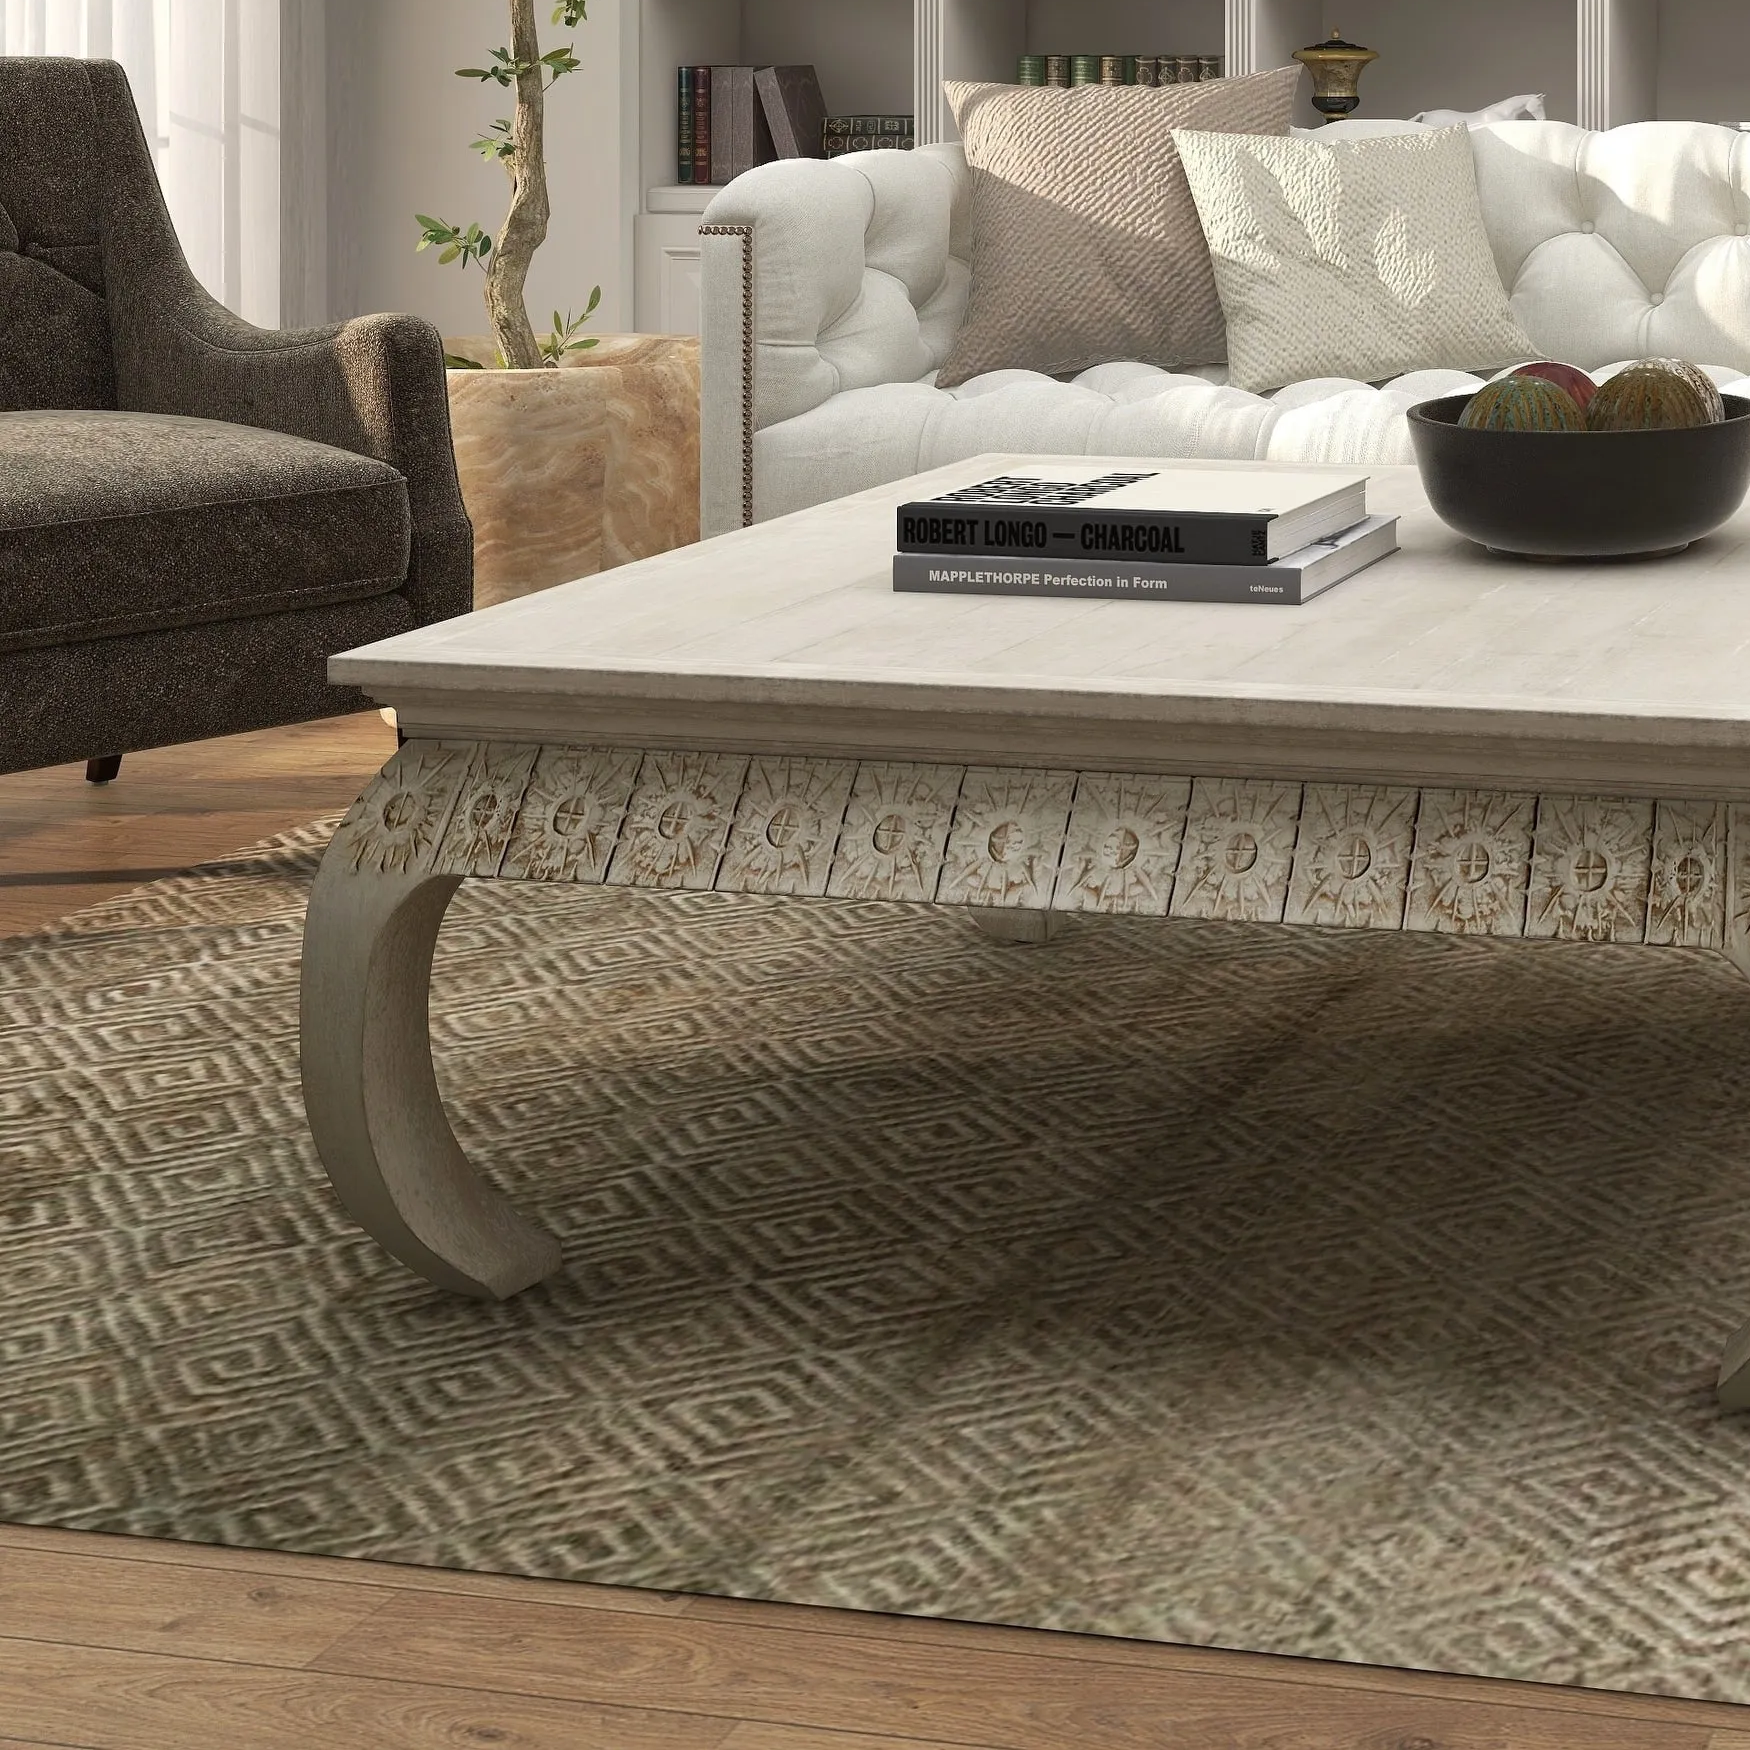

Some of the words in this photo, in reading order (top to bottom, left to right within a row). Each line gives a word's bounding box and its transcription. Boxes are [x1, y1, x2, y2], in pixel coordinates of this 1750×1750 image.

[931, 477, 1042, 502] ROBERT
[979, 481, 1078, 503] LONGO
[1029, 472, 1160, 505] CHARCOAL
[903, 517, 978, 546] ROBERT
[984, 519, 1047, 548] LONGO
[1081, 523, 1185, 553] CHARCOAL
[929, 570, 1040, 585] MAPPLETHORPE
[1043, 573, 1113, 587] Perfection
[1116, 576, 1129, 588] in
[1133, 576, 1168, 589] Form
[1249, 585, 1284, 593] teNeues
